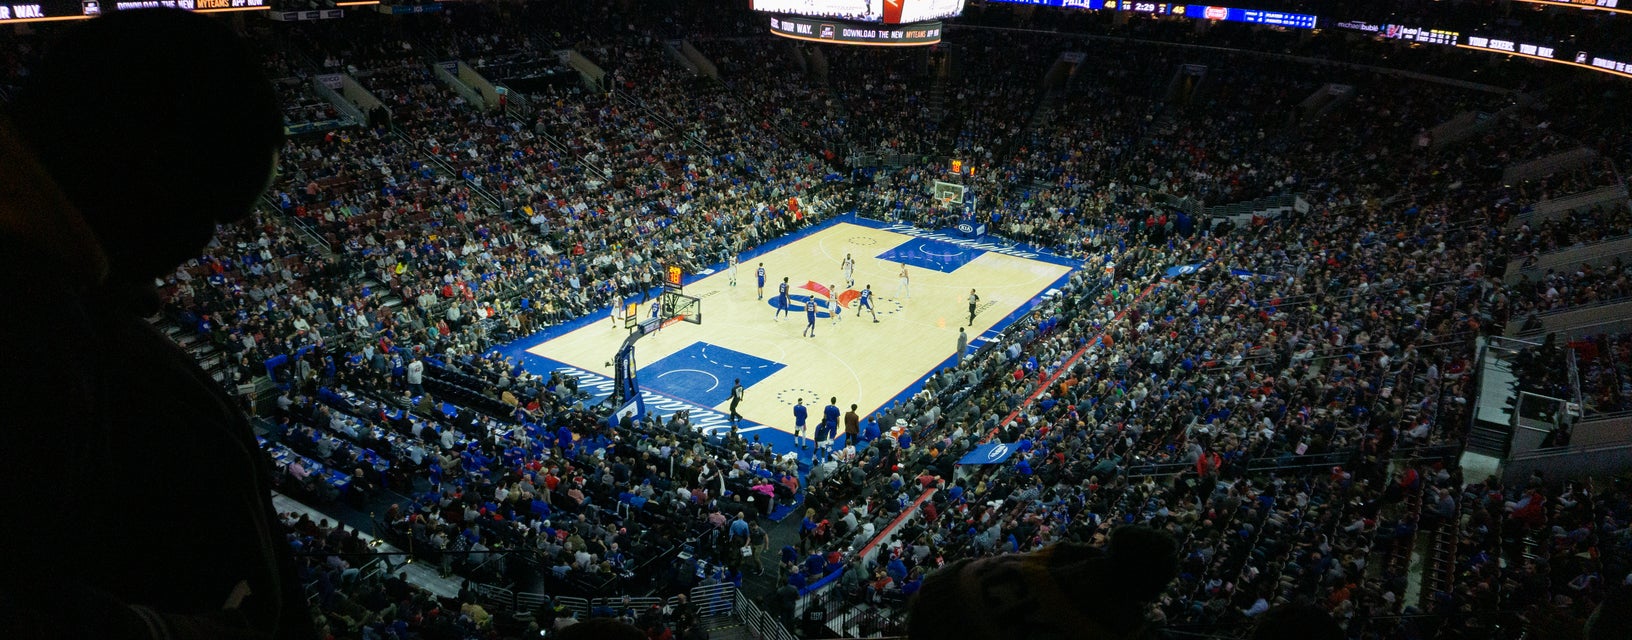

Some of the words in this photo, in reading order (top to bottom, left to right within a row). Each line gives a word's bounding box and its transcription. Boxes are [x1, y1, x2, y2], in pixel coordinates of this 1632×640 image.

[178, 0, 194, 9] NEW
[197, 0, 229, 8] MYTEAMS
[1135, 2, 1155, 12] 2:29
[1172, 6, 1185, 14] 45
[13, 5, 44, 18] WAY.
[781, 21, 795, 32] YOUR
[796, 23, 813, 35] WAY.
[842, 28, 876, 38] DOWNLOAD
[878, 30, 889, 38] THE
[890, 31, 903, 39] NEW
[905, 30, 927, 38] MYTEAMS
[1468, 36, 1489, 47] YOUR
